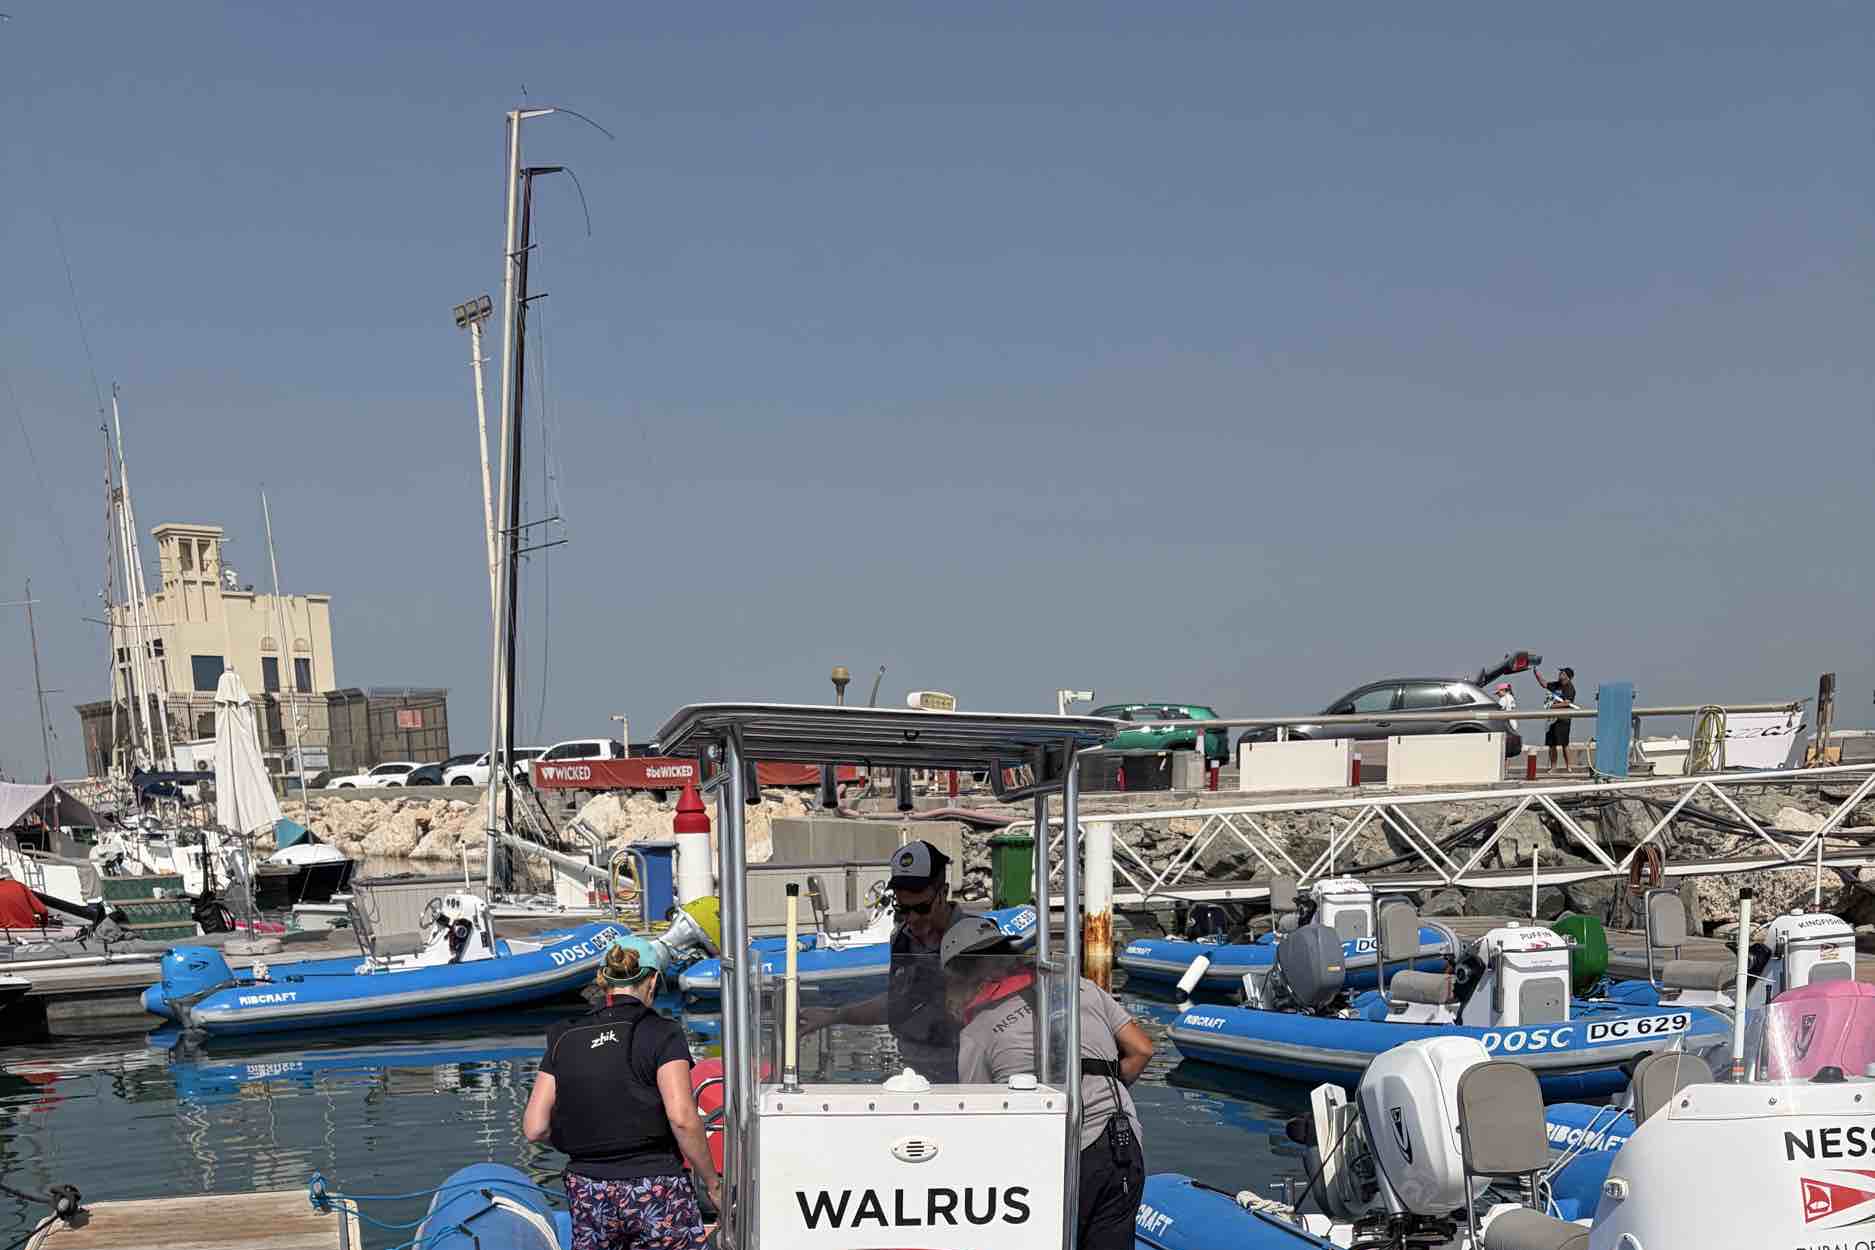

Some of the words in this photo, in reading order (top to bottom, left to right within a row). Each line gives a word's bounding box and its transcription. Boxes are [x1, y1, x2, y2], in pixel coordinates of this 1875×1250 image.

[554, 766, 592, 780] WICKED
[550, 941, 596, 966] DOSC
[238, 992, 297, 1007] RIBCRAFT
[1183, 1013, 1226, 1031] RIBCRAFT
[1479, 1026, 1574, 1051] DOSC
[1590, 1021, 1630, 1041] DC
[1636, 1014, 1688, 1035] 629
[590, 1030, 619, 1049] zhik
[1783, 1126, 1875, 1161] NES
[795, 1186, 1031, 1230] WALRUS
